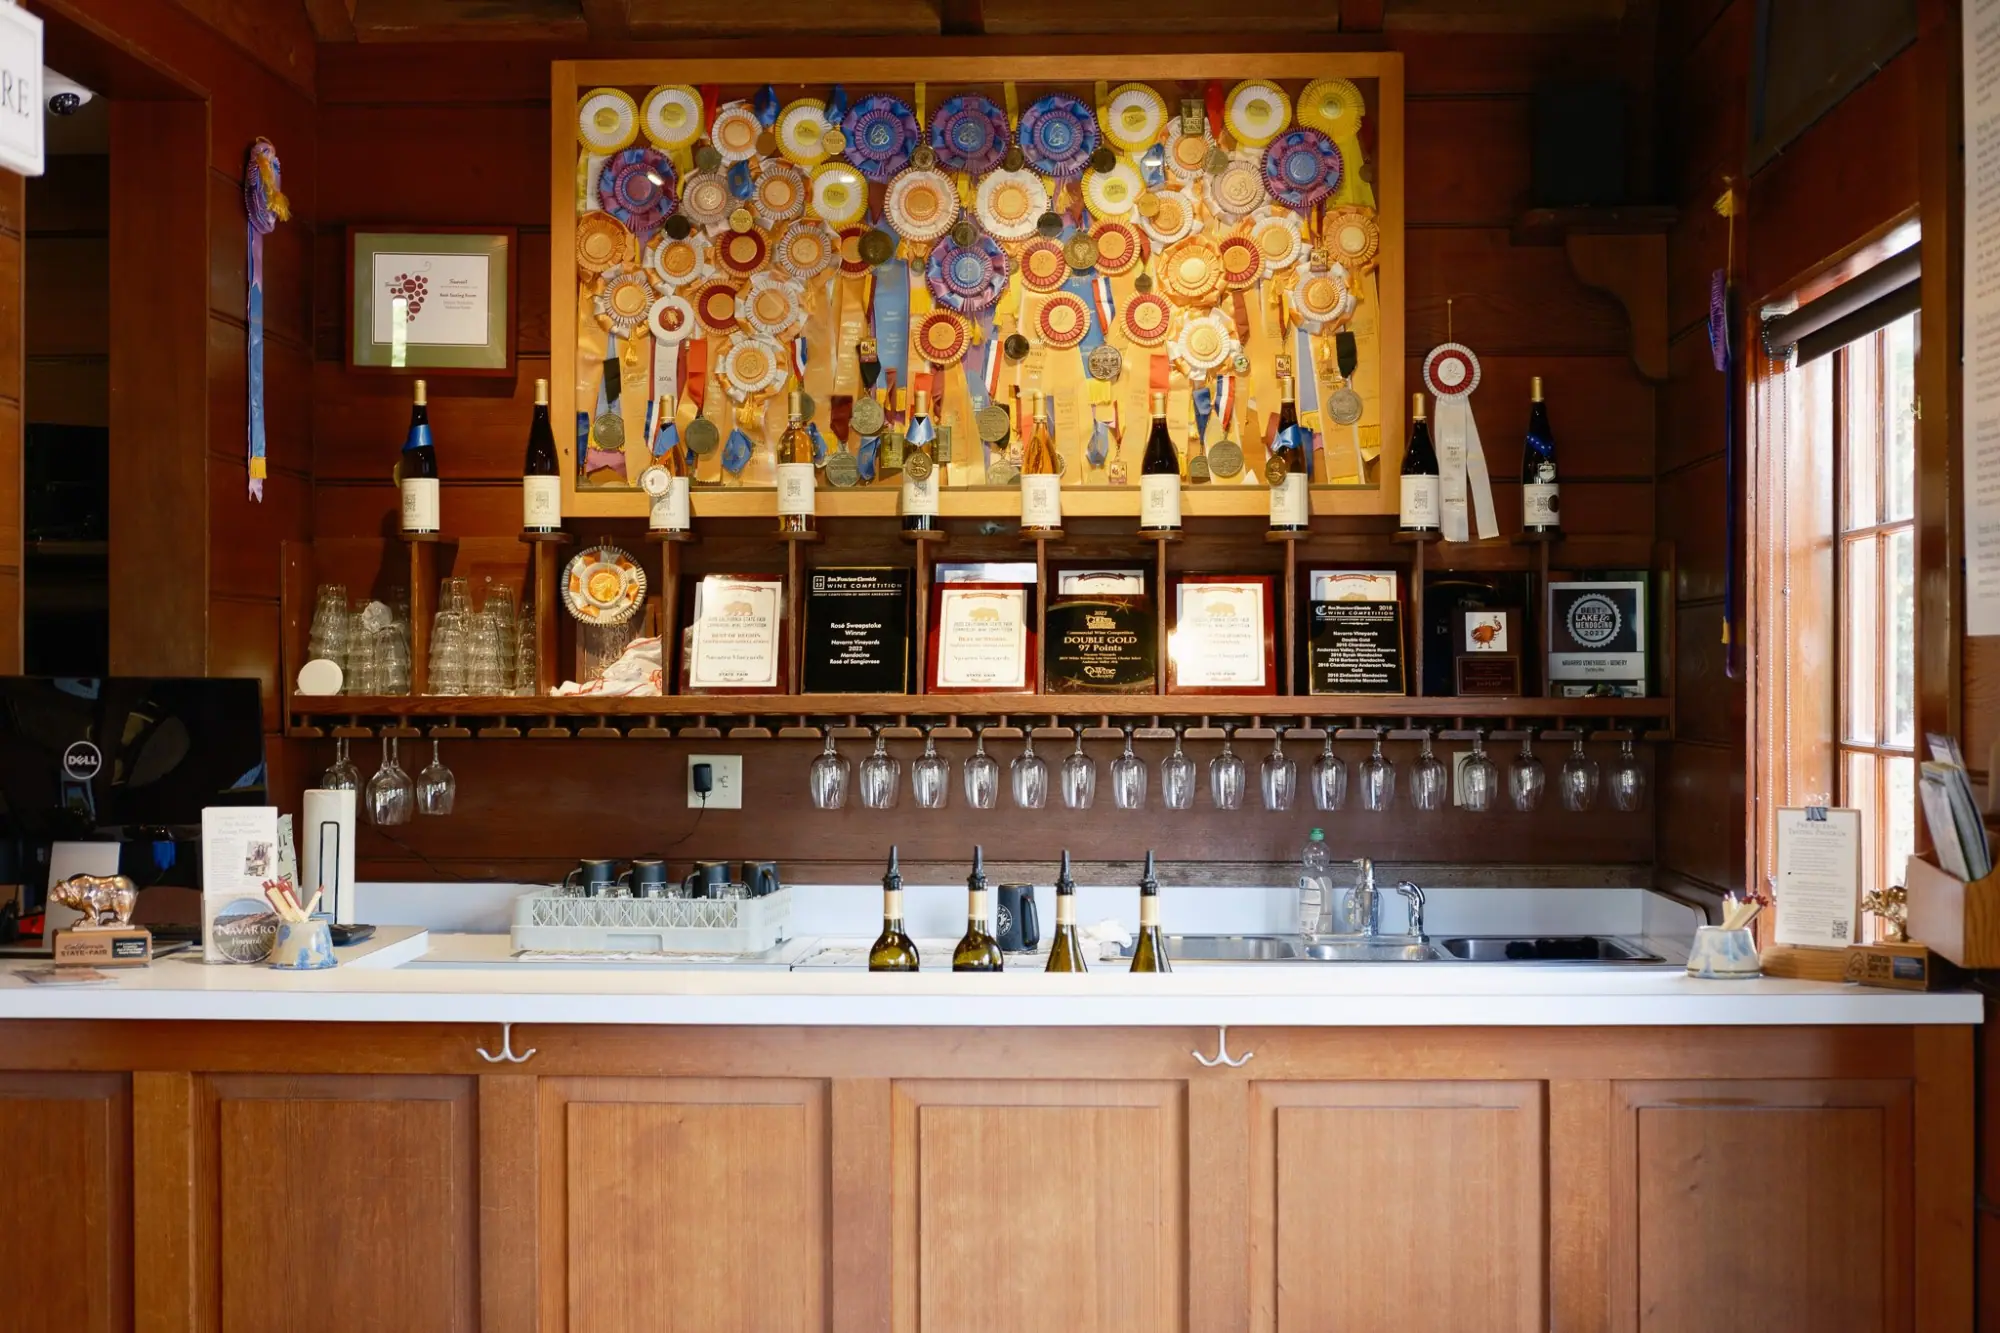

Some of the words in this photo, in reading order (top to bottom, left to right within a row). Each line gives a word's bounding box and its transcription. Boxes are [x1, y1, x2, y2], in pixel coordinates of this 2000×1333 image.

[68, 755, 98, 765] DELL
[218, 925, 276, 936] NAVARRO
[64, 942, 104, 950] California
